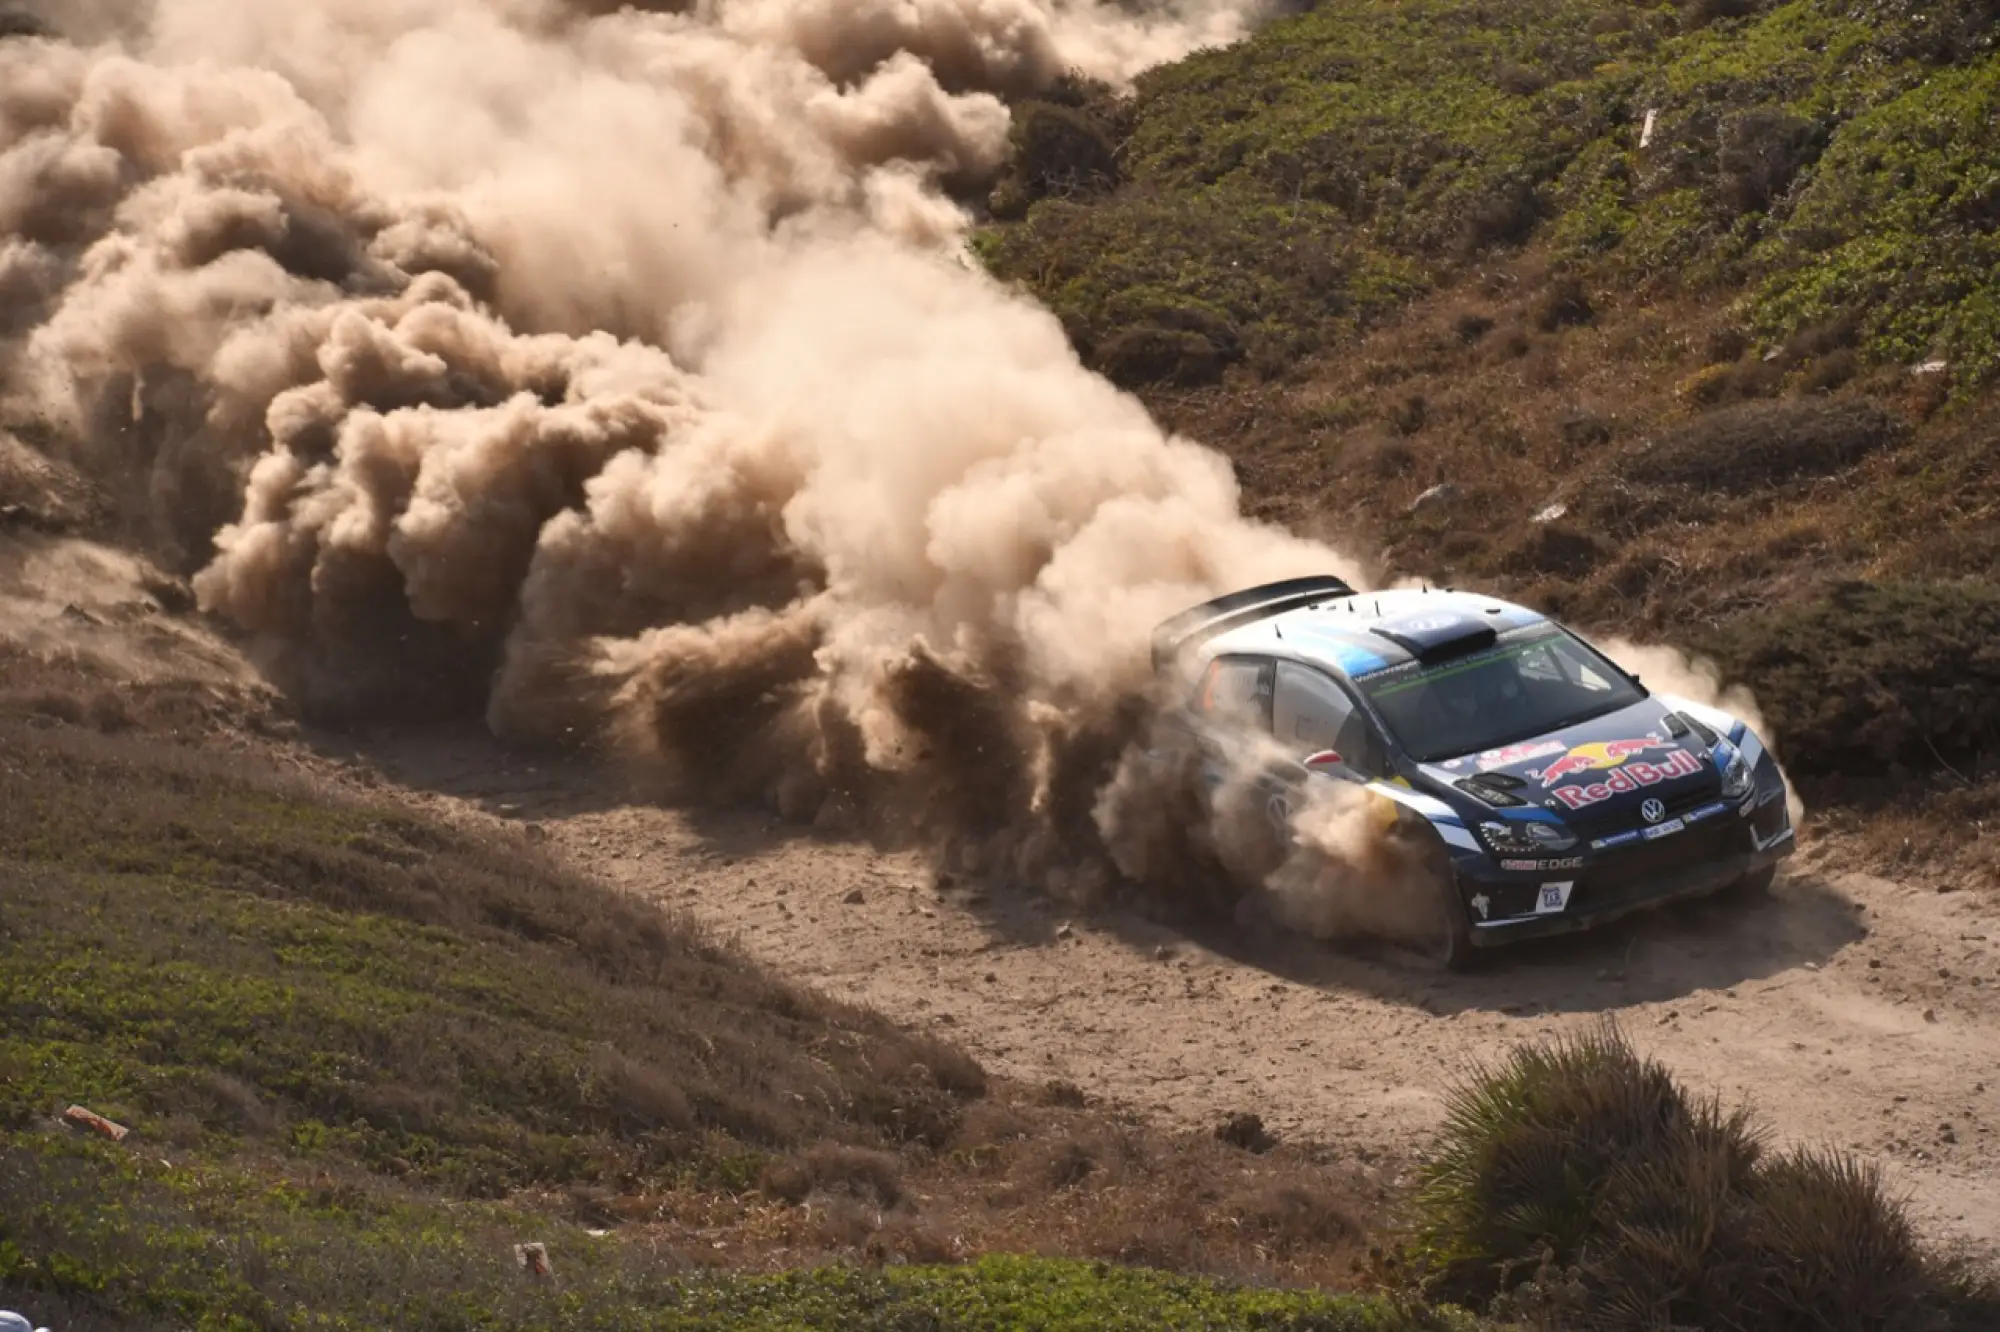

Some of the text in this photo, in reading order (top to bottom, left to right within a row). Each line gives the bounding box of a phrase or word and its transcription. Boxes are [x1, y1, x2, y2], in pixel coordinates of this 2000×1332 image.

[1552, 749, 1703, 809] Red Bull
[1538, 856, 1584, 871] EDGE
